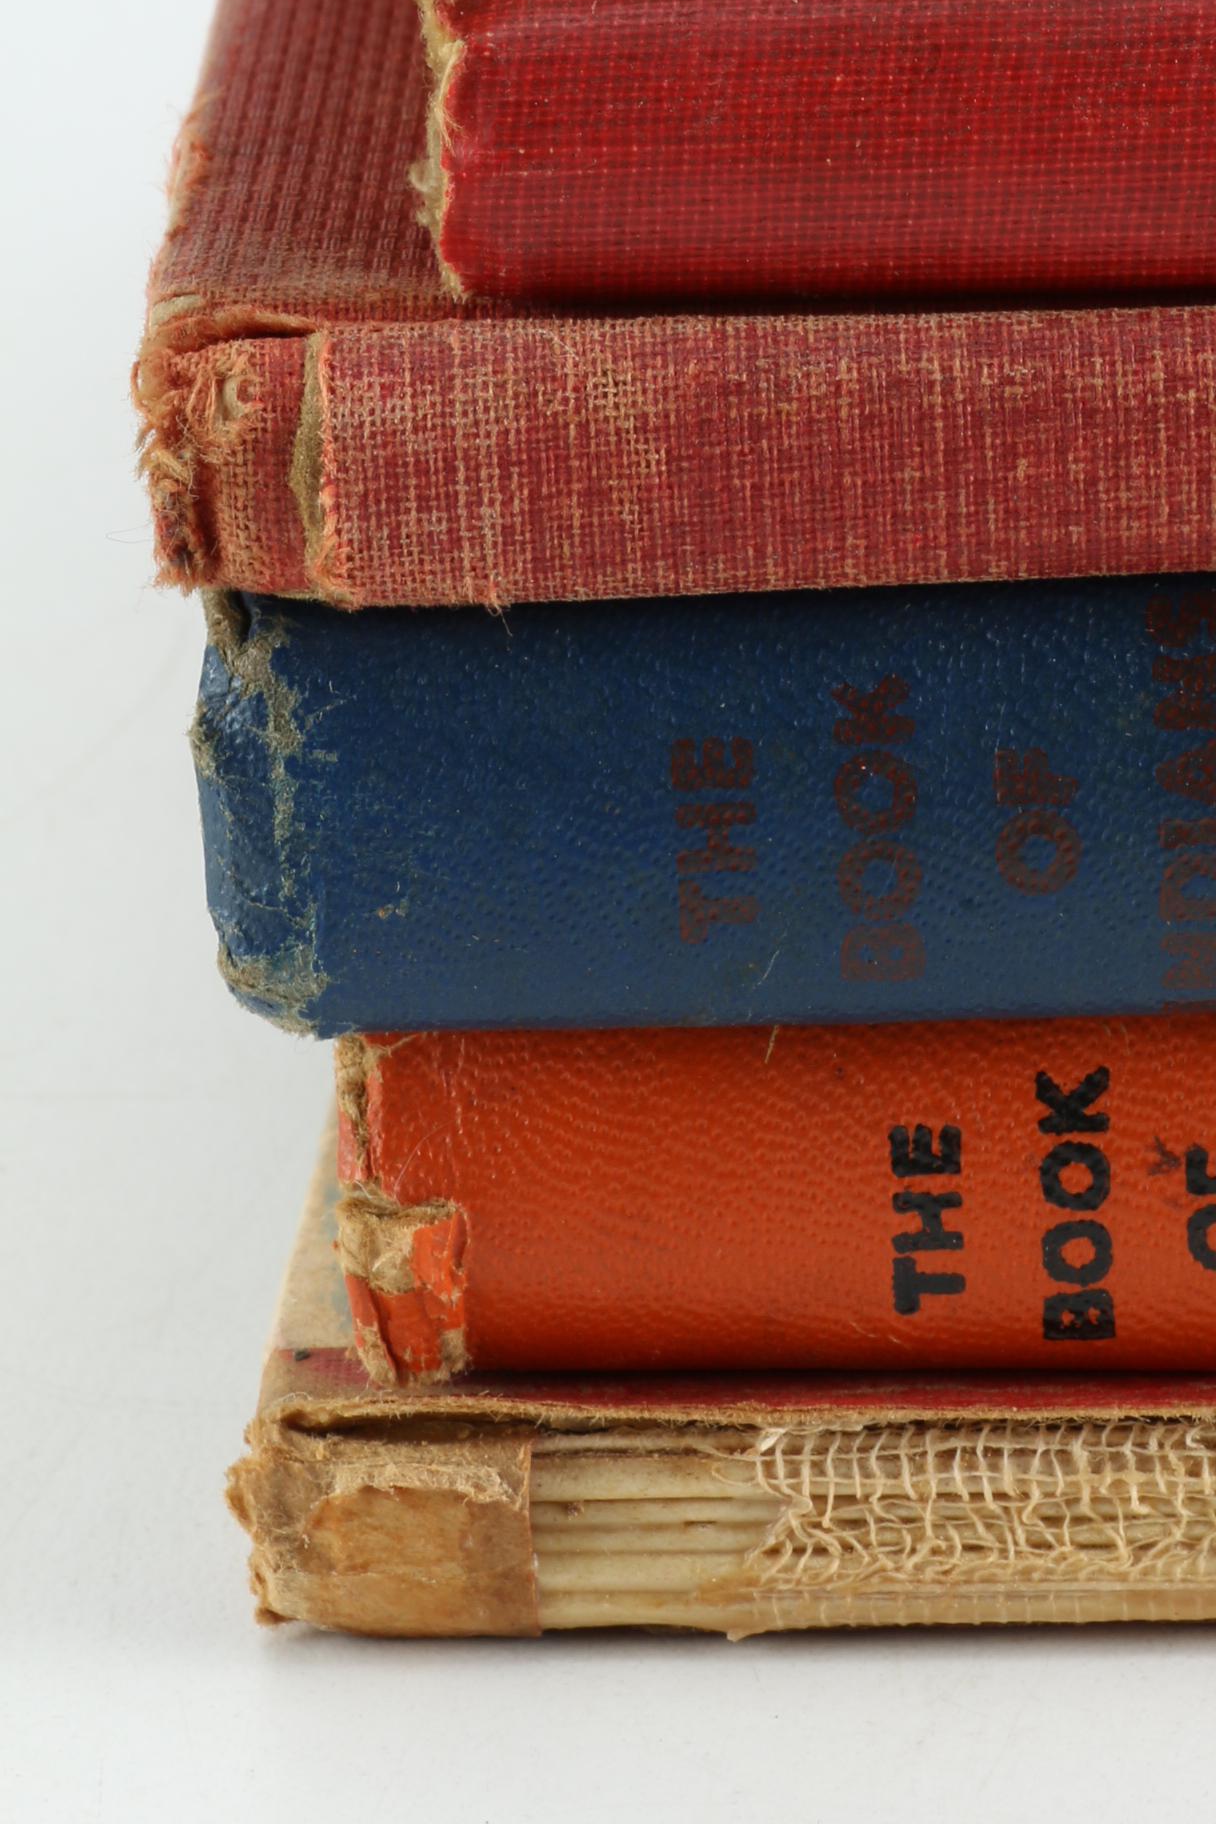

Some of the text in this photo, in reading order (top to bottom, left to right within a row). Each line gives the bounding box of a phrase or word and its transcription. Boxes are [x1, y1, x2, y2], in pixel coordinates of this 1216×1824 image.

[671, 736, 761, 944] THE
[831, 674, 927, 983] BOOK
[992, 747, 1083, 896] OF
[888, 1123, 966, 1316] THE
[1035, 1065, 1117, 1341] BOOK
